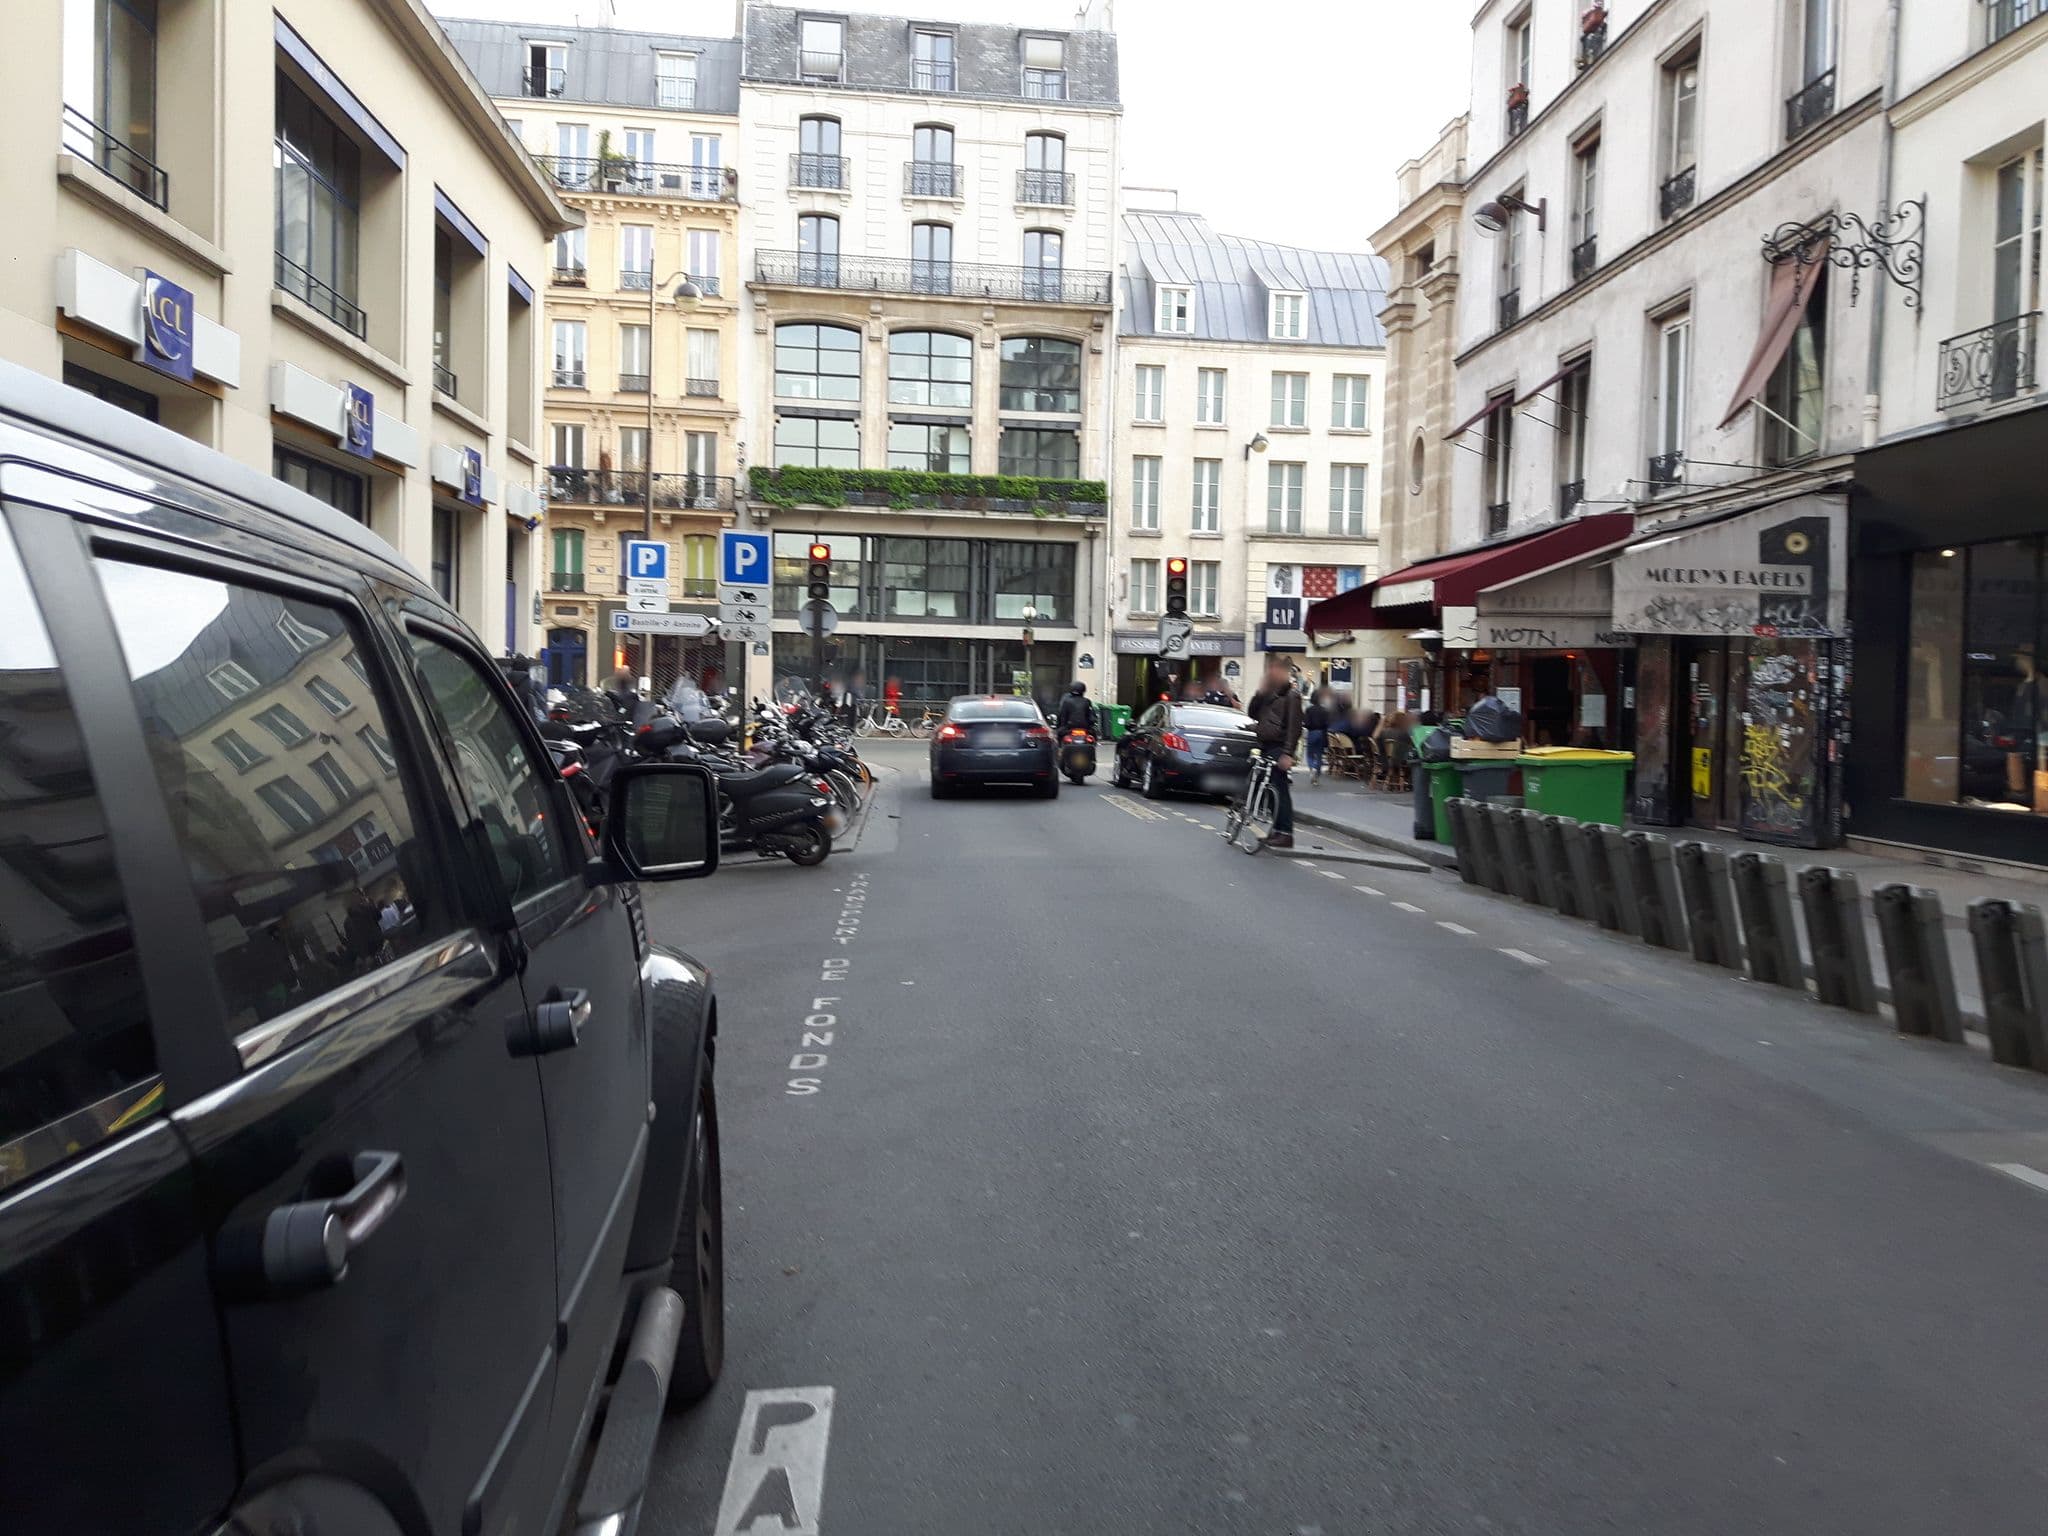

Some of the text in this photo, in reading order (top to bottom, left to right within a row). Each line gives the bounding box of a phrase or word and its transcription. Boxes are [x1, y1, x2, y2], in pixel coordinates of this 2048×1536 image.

[149, 291, 187, 336] LCL
[352, 400, 369, 426] LCL
[638, 547, 658, 575] P
[735, 541, 758, 575] P
[1646, 568, 1806, 587] MORRY'S BAGELS
[617, 616, 627, 627] P
[1272, 608, 1295, 625] GAP
[821, 958, 850, 981] DE
[785, 997, 842, 1096] FONDS
